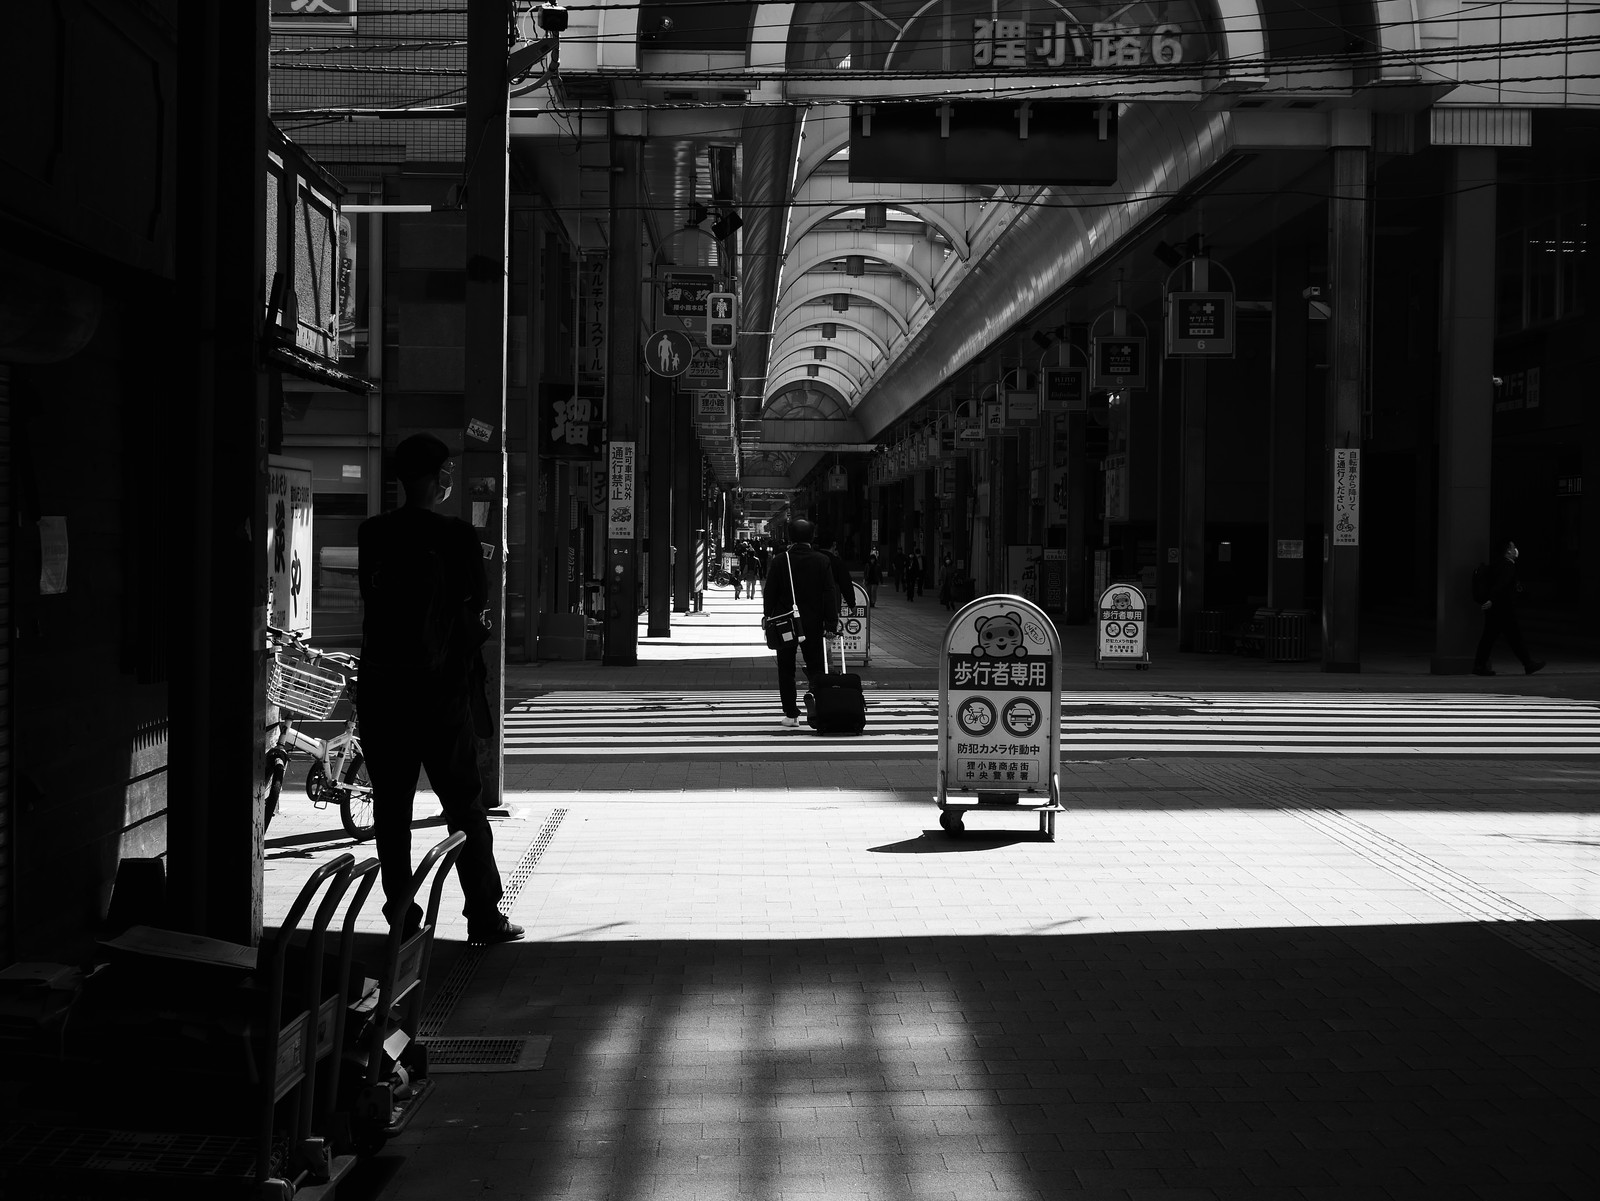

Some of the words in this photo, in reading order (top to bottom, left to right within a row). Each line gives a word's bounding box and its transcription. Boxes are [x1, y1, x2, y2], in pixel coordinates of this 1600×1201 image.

[591, 262, 604, 371] カルチャースクール
[683, 318, 692, 328] 6
[1197, 340, 1206, 350] 6
[1116, 376, 1124, 385] 6
[611, 447, 624, 501] 通行禁止
[624, 447, 633, 501] 許可車両以外
[1336, 451, 1346, 512] ご通行ください
[1348, 451, 1358, 511] 自転車から降りて
[1102, 610, 1142, 620] 歩行者専用
[954, 661, 1047, 687] 歩行者専用
[957, 743, 1040, 756] 防犯カメラ作動中
[966, 761, 1030, 772] 狸小路商店街
[966, 771, 1029, 782] 中央警察署
